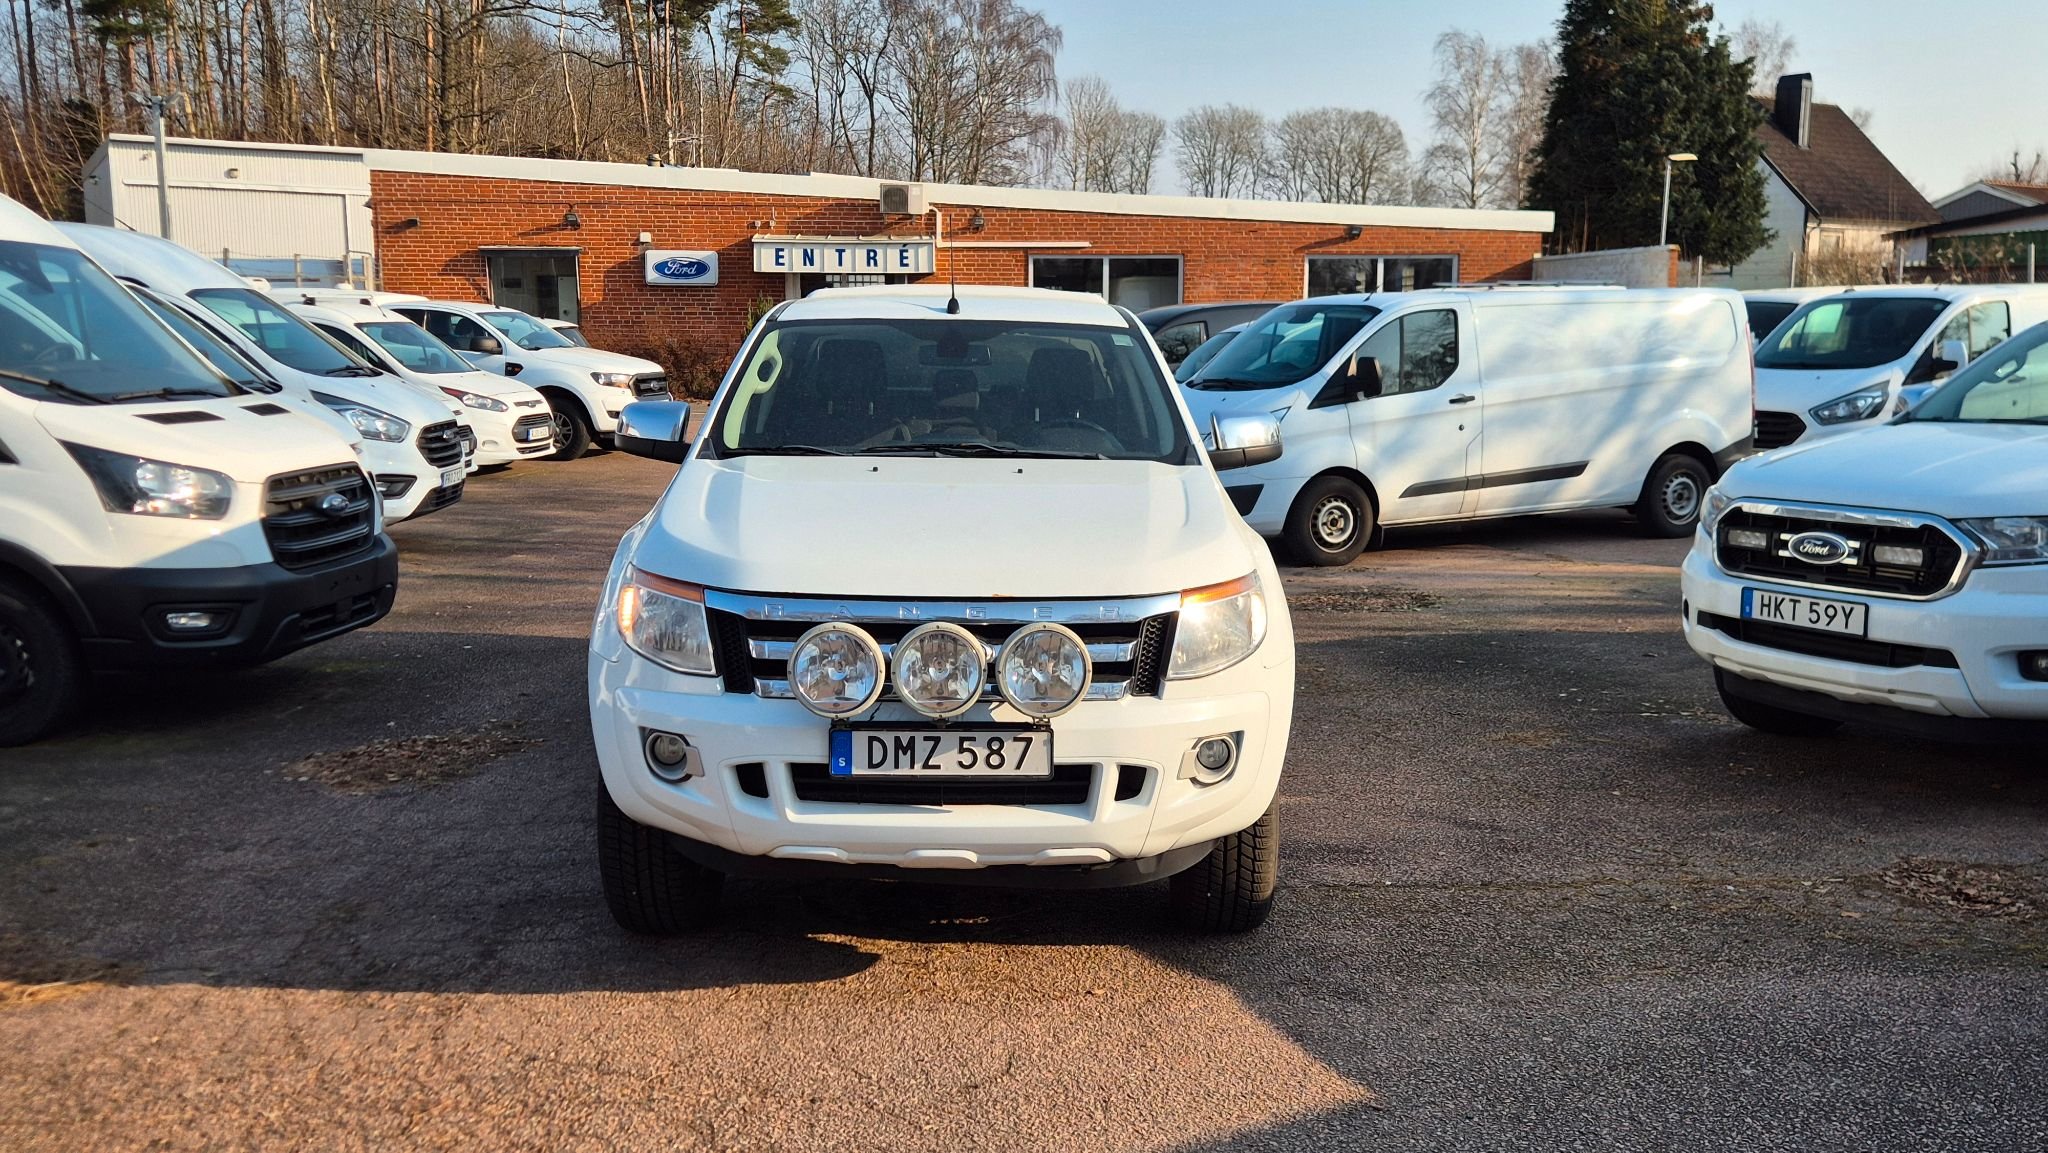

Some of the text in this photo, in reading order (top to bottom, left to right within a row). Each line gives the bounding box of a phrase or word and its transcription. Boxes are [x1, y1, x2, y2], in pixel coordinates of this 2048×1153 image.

[664, 258, 699, 275] Ford
[774, 244, 910, 268] ENTRÉ
[1799, 538, 1831, 556] Ford
[763, 603, 1121, 620] RANGER
[1759, 594, 1855, 630] HKT 59Y
[838, 735, 1034, 771] S DMZ 587
